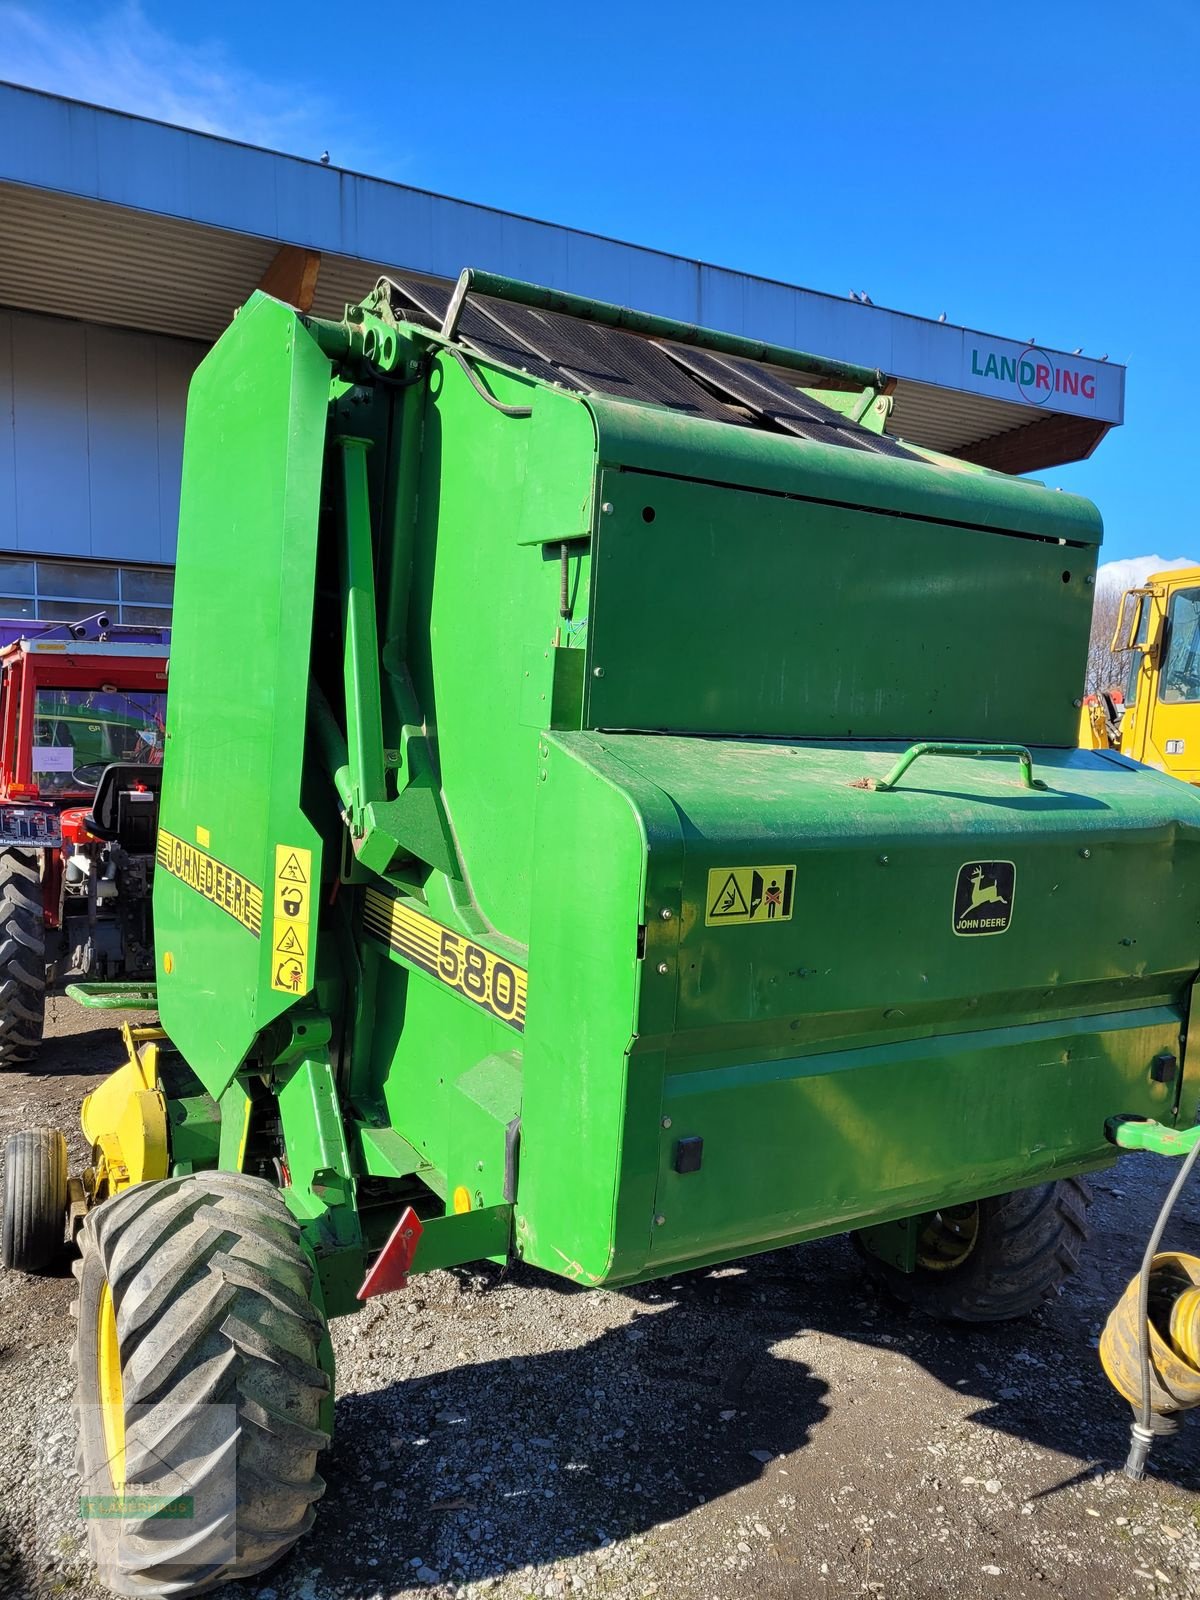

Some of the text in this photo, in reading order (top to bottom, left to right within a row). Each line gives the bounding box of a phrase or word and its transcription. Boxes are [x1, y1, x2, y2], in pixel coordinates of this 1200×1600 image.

[972, 349, 1095, 399] LANDRING
[167, 838, 252, 924] JOHN DEERE
[956, 917, 1006, 929] JOHN DEERE
[439, 930, 516, 1015] 580
